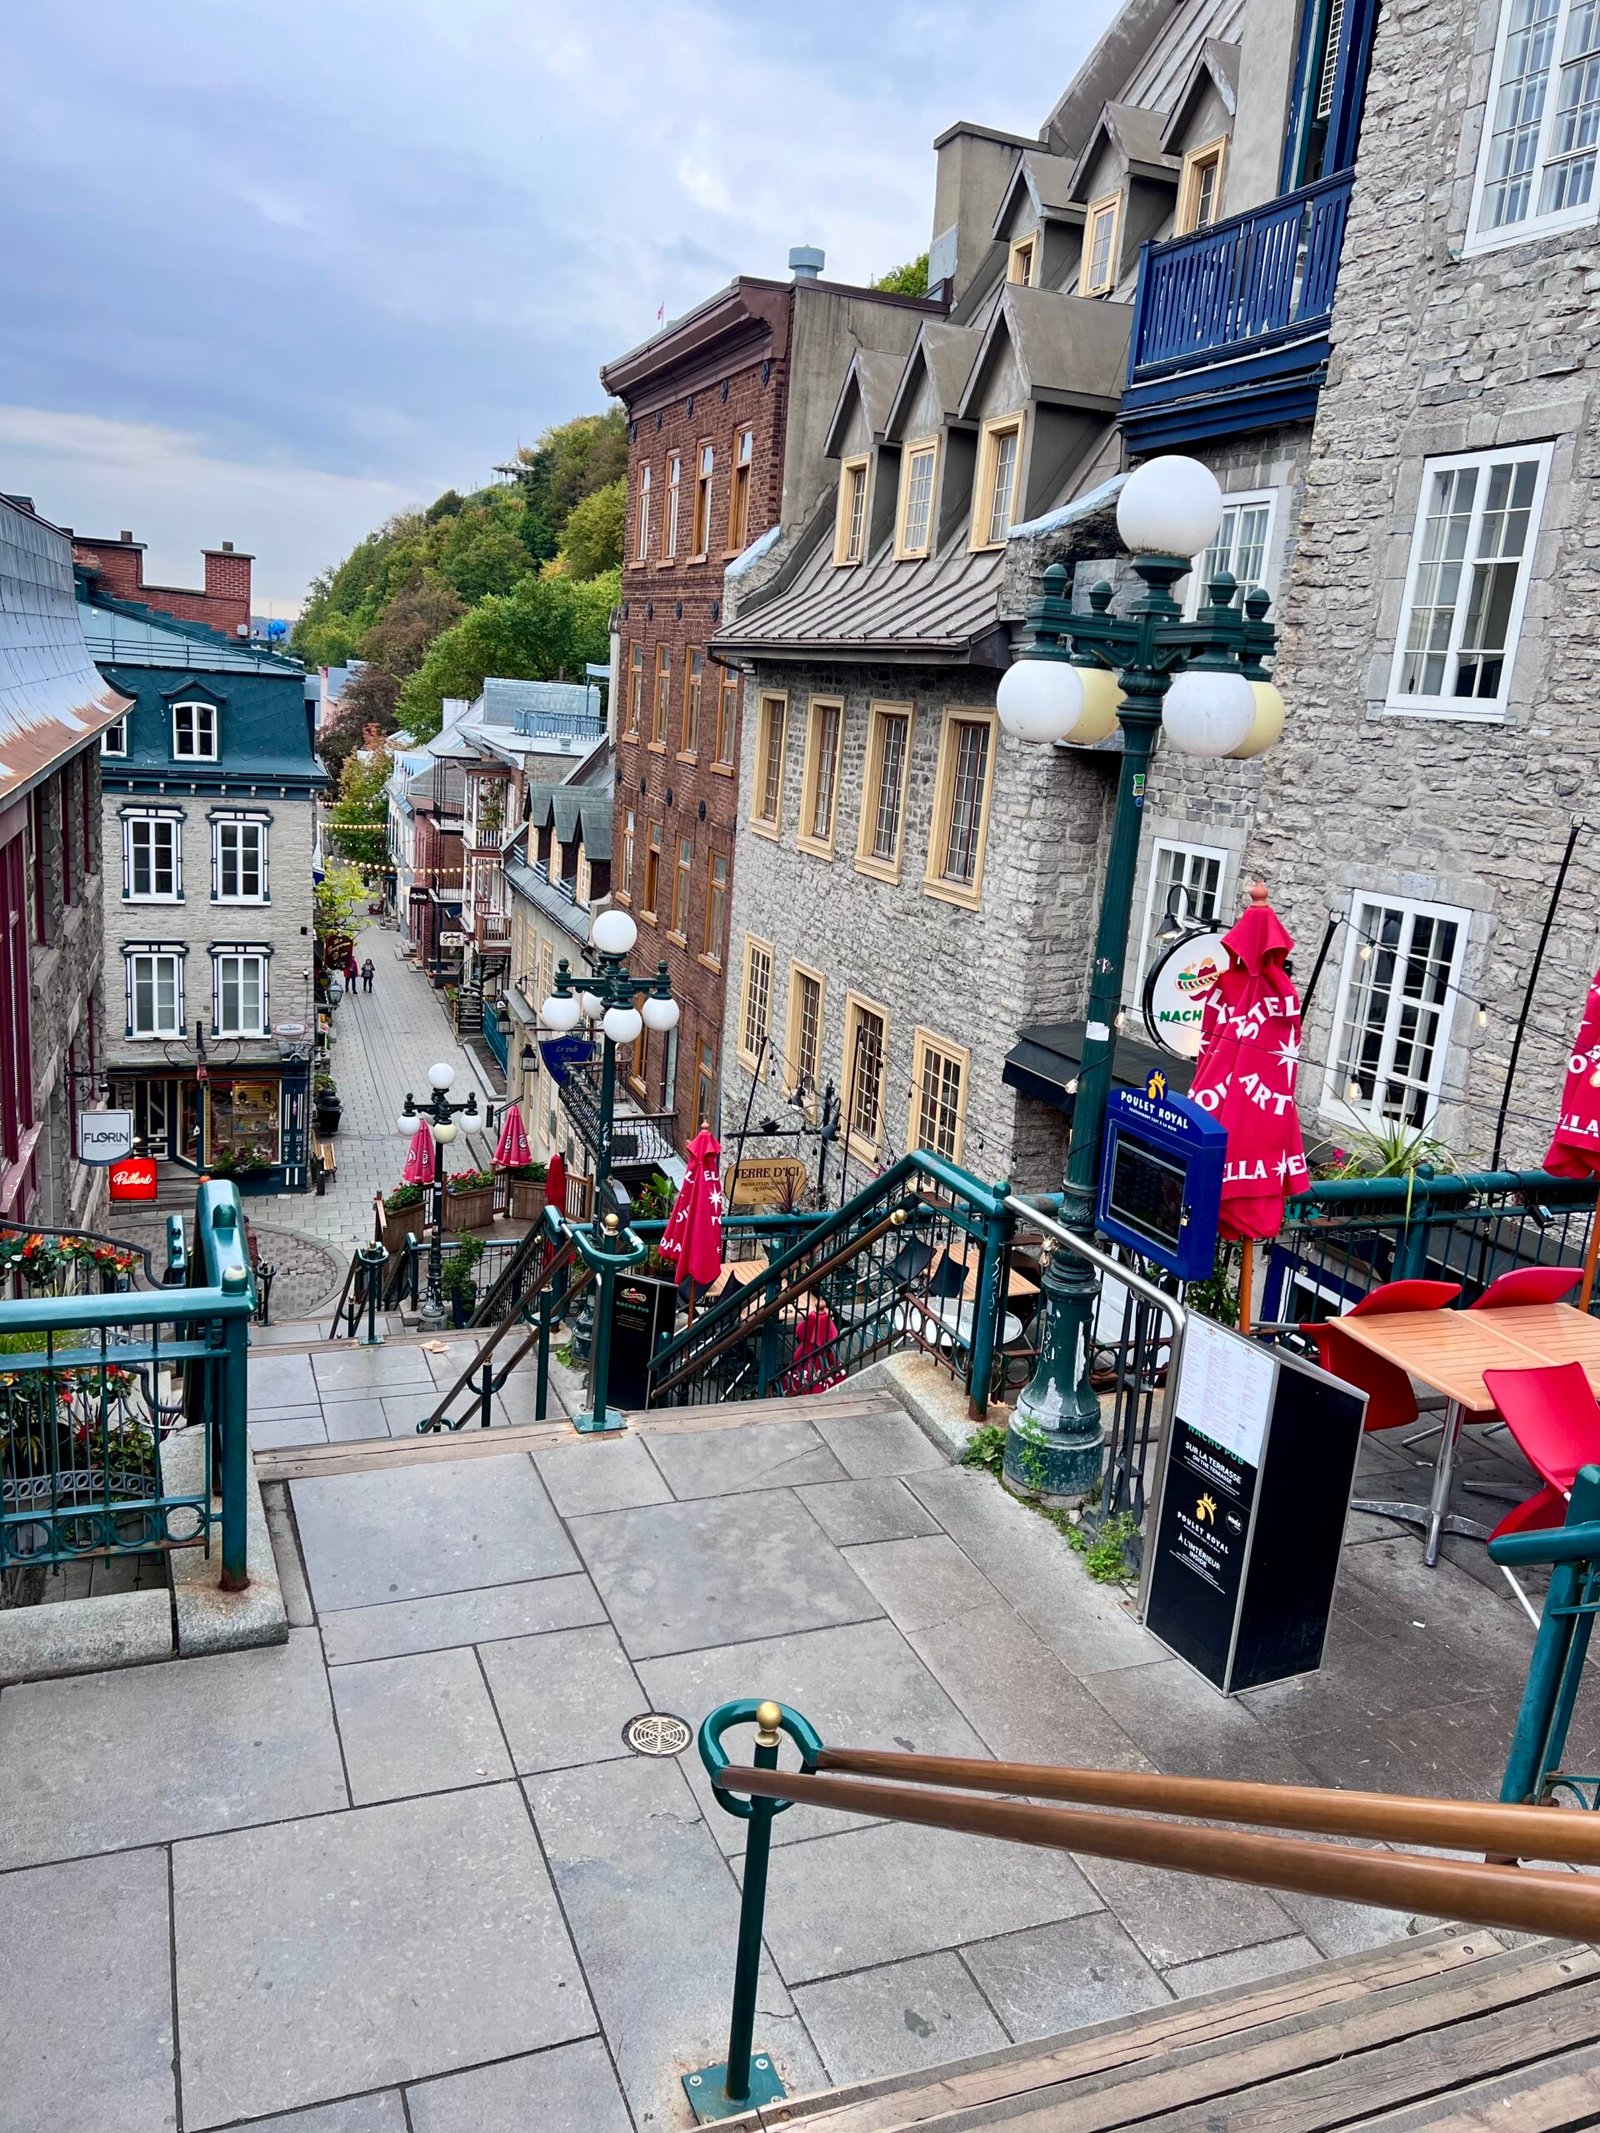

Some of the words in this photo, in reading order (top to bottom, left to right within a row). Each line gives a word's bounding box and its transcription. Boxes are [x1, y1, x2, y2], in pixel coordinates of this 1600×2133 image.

[1160, 1010, 1203, 1022] NACH
[1242, 995, 1301, 1040] STEL
[1239, 1073, 1293, 1116] ART
[1121, 1091, 1155, 1114] POULET
[1158, 1108, 1189, 1129] ROYAL
[83, 1132, 129, 1143] FLORIN
[113, 1171, 152, 1185] Paillard
[773, 1166, 799, 1178] D'ICI
[616, 1301, 637, 1310] NACHO
[1184, 1441, 1199, 1454] SUR
[1199, 1450, 1208, 1461] LA
[1208, 1456, 1242, 1485] TERRASSE
[1200, 1460, 1210, 1469] THE
[1224, 1448, 1244, 1466] PUB
[1177, 1511, 1204, 1535] POULET
[1206, 1532, 1229, 1555] ROYAL
[1189, 1551, 1207, 1569] INSIDE
